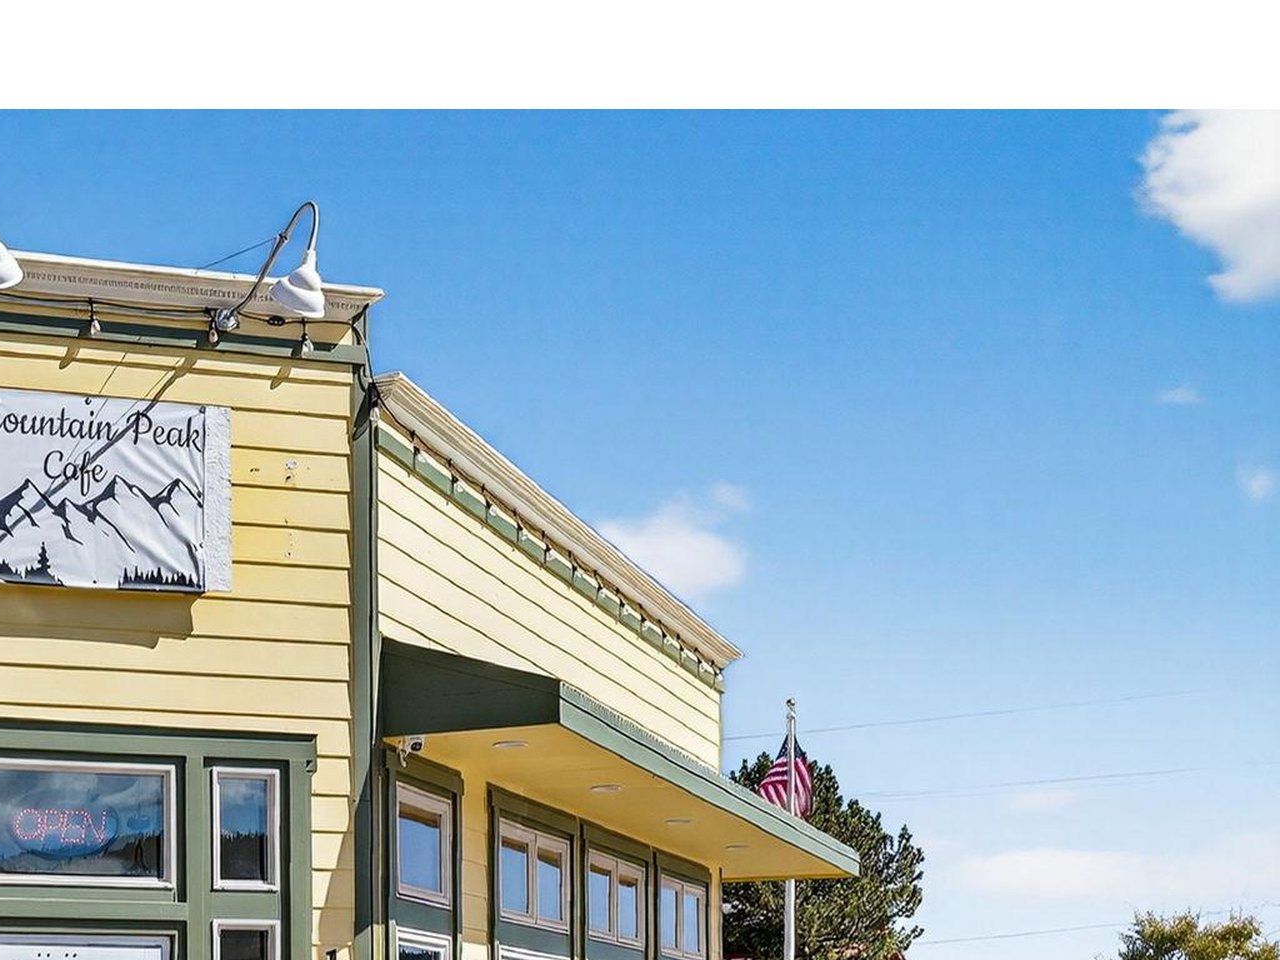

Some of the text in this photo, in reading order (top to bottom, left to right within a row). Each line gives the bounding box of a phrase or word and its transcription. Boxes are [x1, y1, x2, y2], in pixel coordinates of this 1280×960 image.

[126, 410, 202, 452] Peak
[43, 450, 108, 496] Cafe
[15, 807, 107, 846] OPEN
